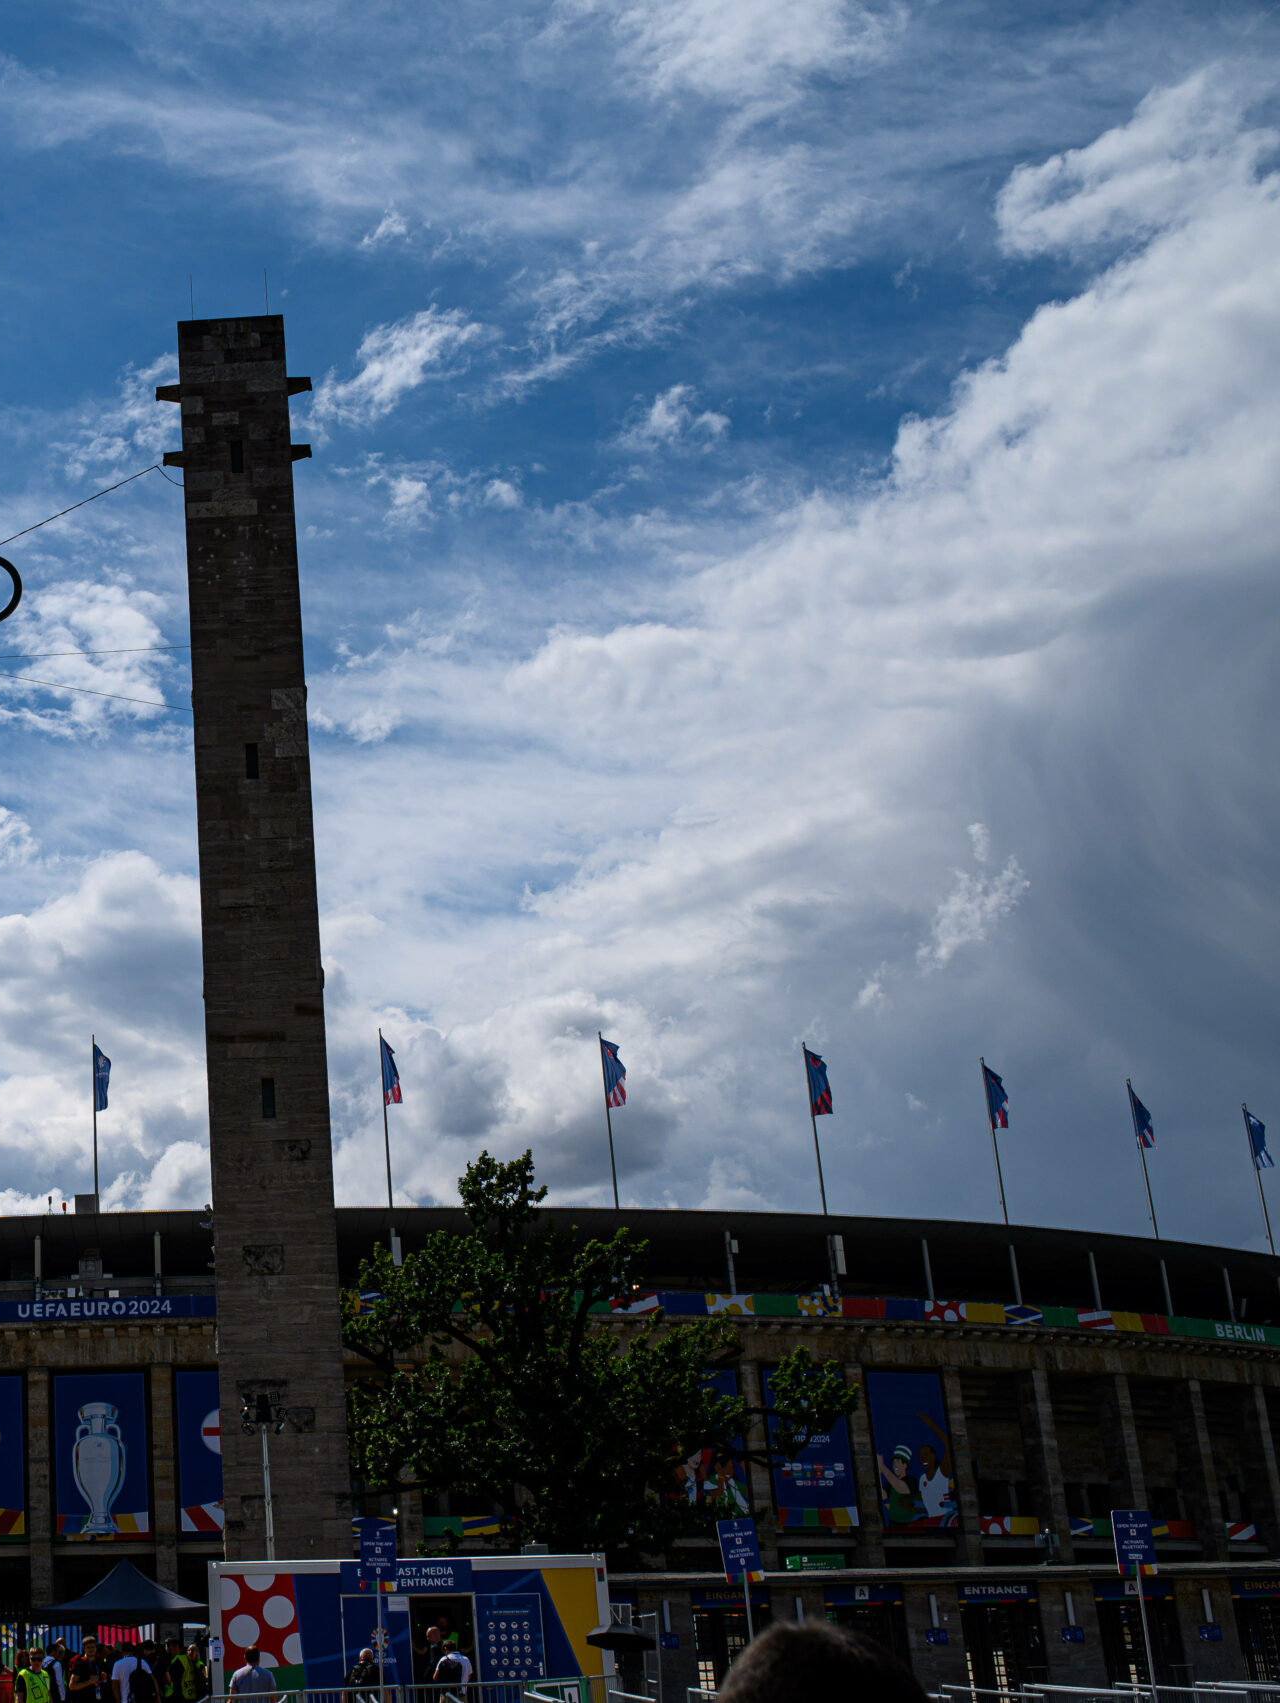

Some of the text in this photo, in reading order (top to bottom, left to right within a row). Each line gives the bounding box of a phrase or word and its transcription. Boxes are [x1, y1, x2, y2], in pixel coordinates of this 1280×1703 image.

[1215, 1323, 1266, 1342] BERLIN
[421, 1566, 454, 1576] MEDIA
[401, 1577, 454, 1587] ENTRANCE
[1243, 1580, 1280, 1590] EINGA
[963, 1585, 1029, 1595] ENTRANCE
[705, 1591, 752, 1601] EINGAN
